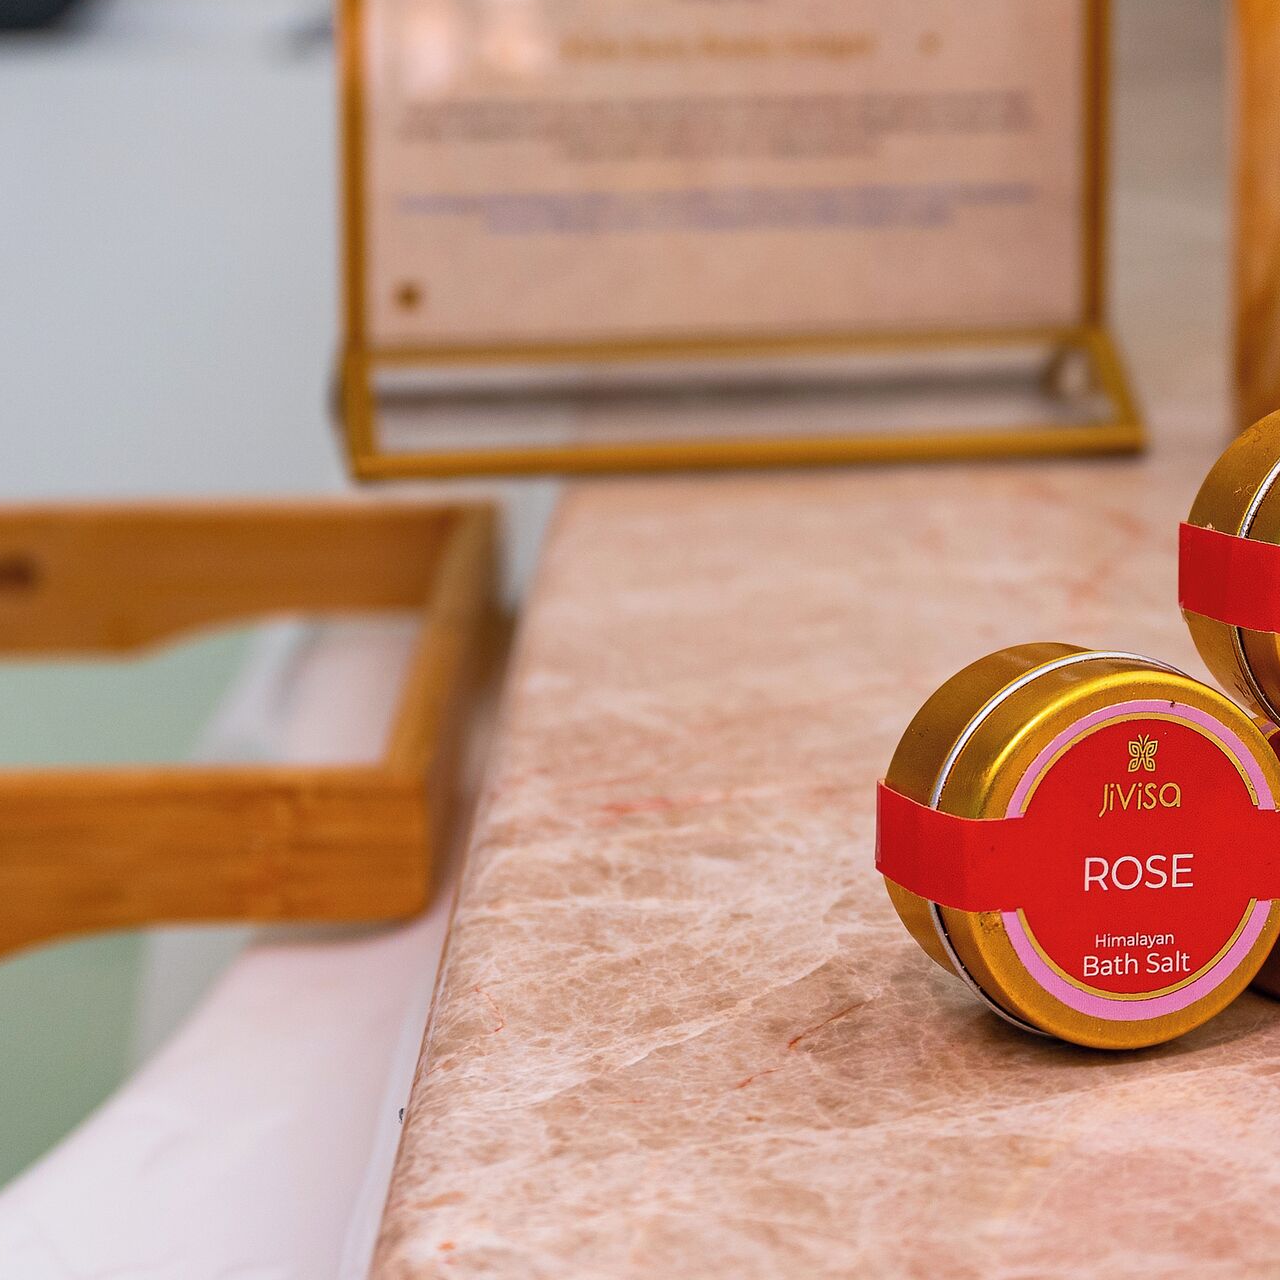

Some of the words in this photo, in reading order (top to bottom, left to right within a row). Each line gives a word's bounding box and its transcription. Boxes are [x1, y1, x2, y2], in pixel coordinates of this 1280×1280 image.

[1083, 854, 1194, 891] ROSE
[1095, 932, 1174, 948] Himalayan
[1083, 953, 1139, 977] Bath
[1146, 951, 1190, 974] Salt
